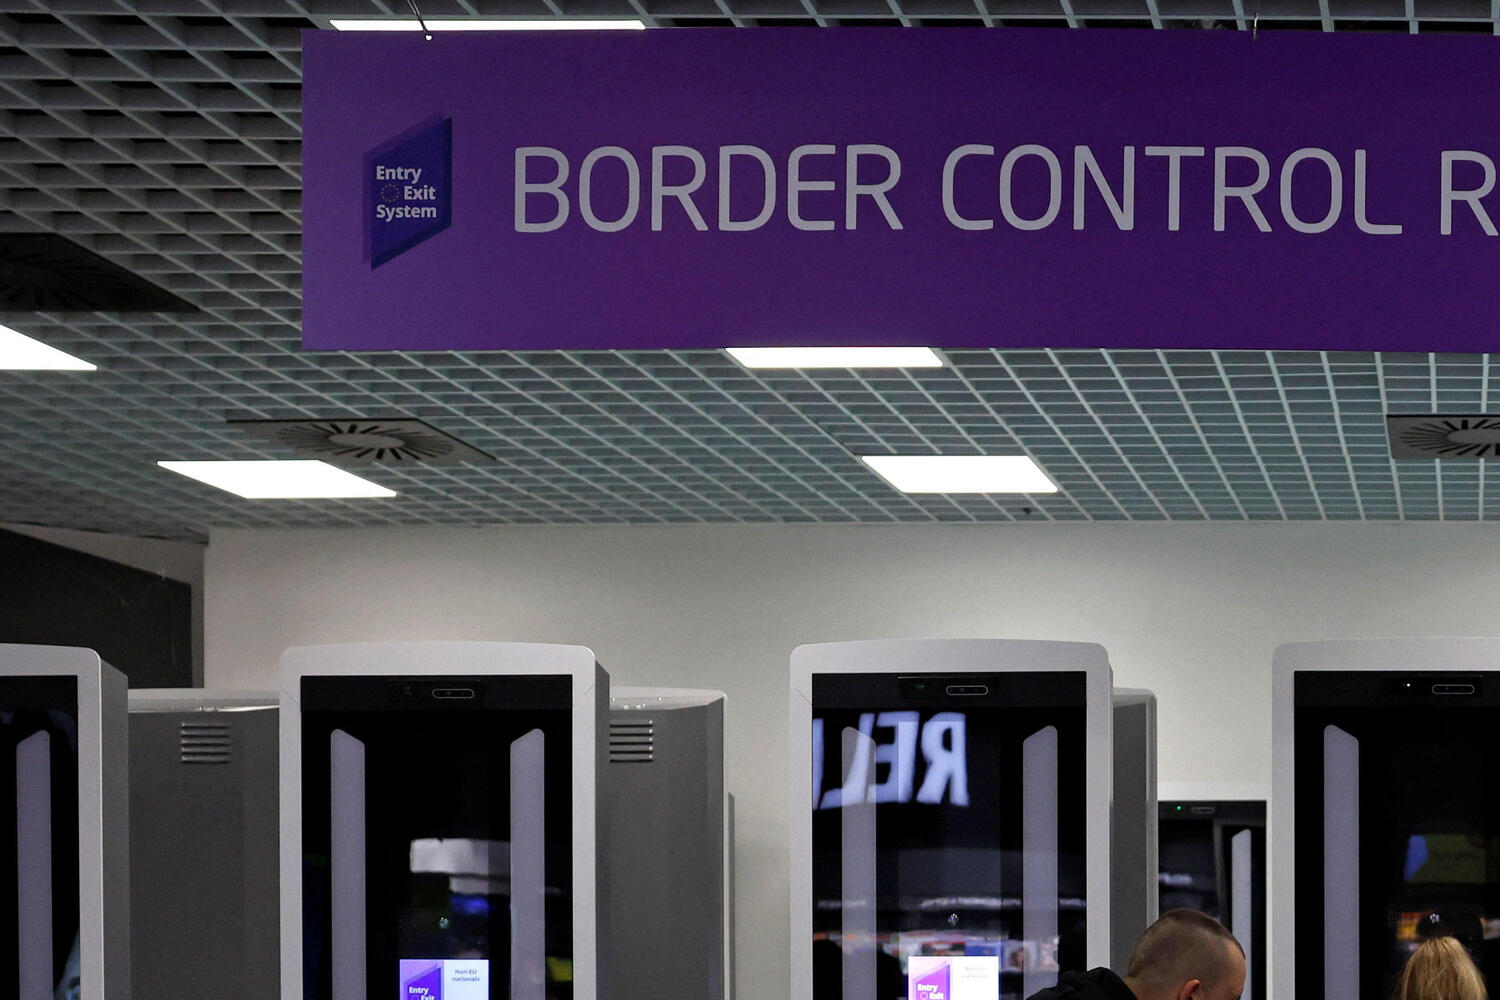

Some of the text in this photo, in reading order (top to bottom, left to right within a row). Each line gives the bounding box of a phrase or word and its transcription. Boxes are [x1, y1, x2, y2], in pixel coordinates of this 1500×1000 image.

[376, 165, 422, 183] Entry
[403, 184, 436, 200] Exit
[514, 144, 904, 233] BORDER
[942, 144, 1403, 236] CONTROL
[376, 204, 437, 222] System
[408, 986, 429, 996] Entry
[917, 983, 938, 993] Entry
